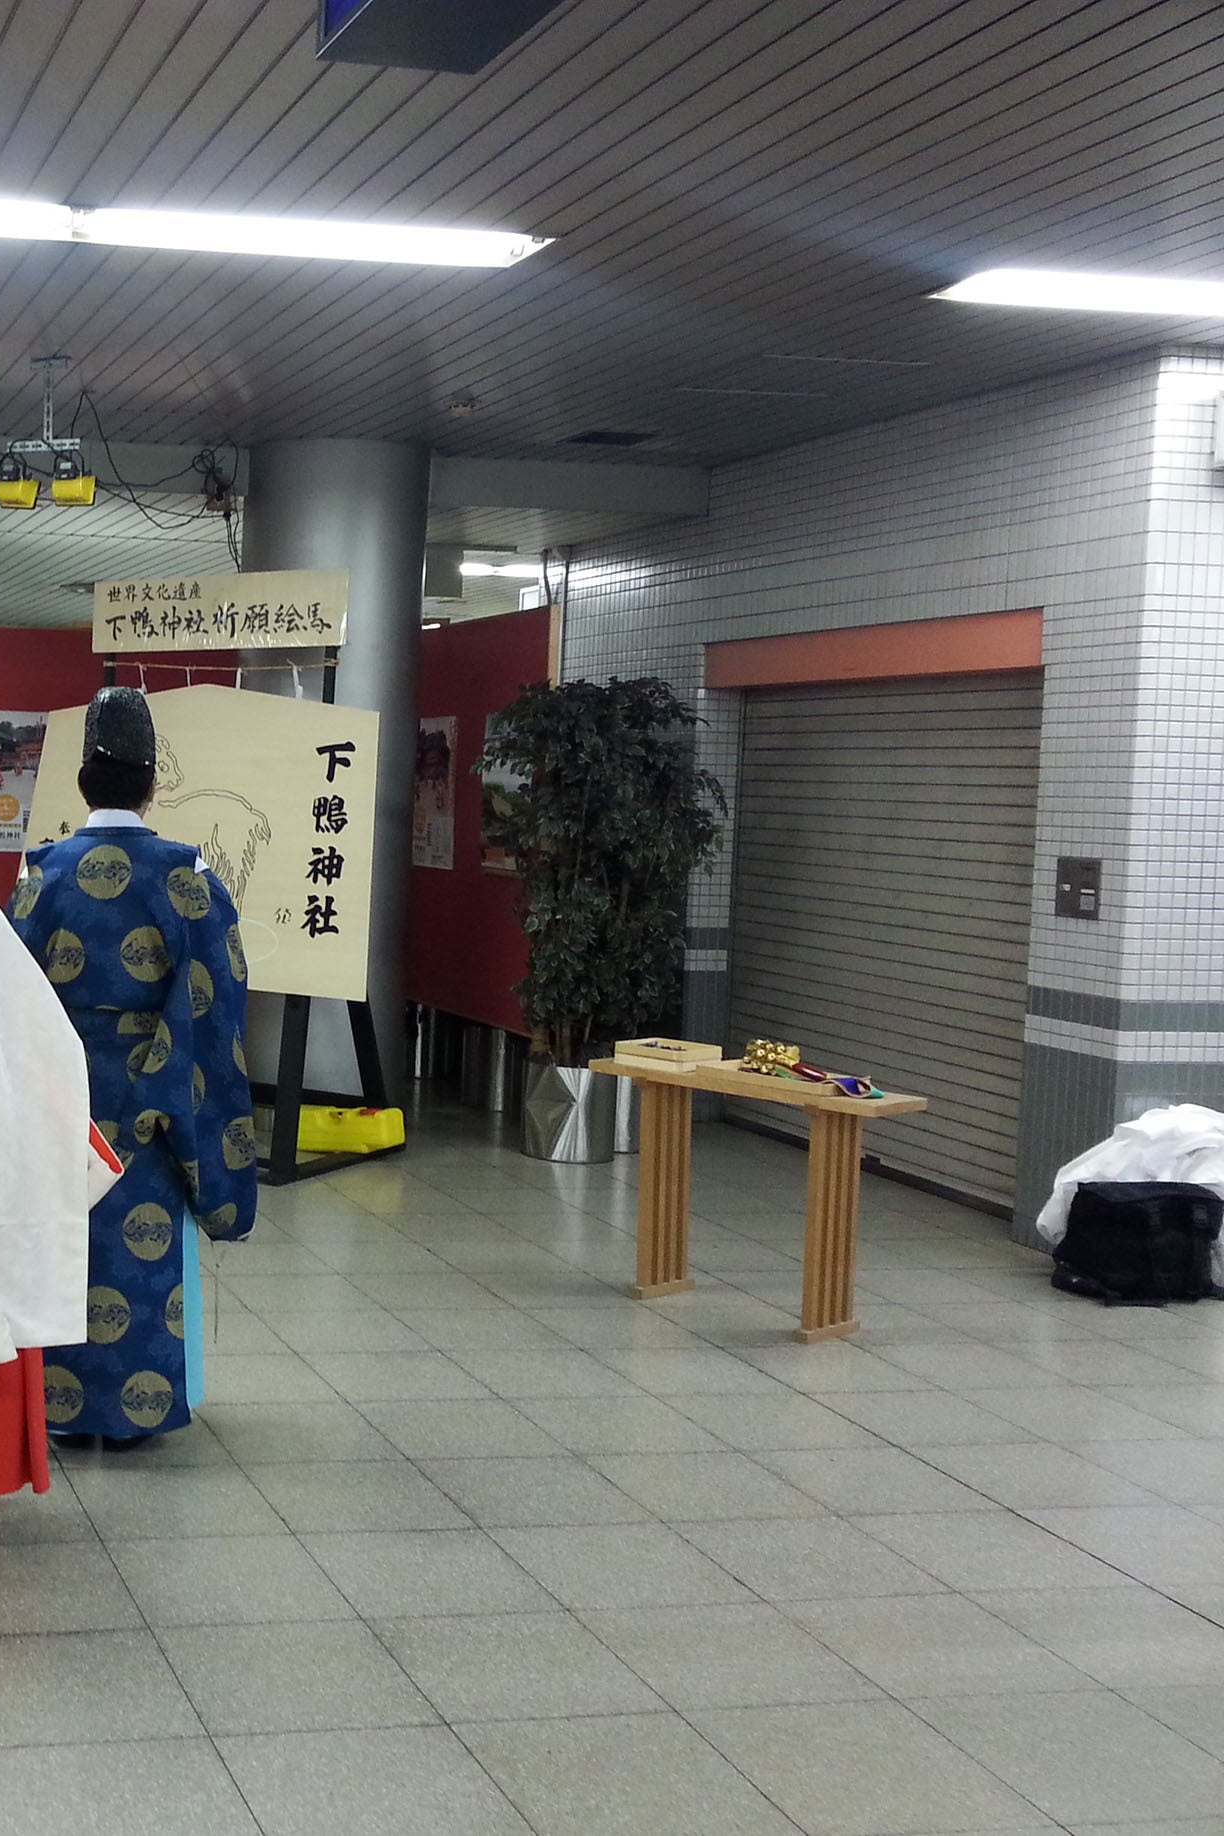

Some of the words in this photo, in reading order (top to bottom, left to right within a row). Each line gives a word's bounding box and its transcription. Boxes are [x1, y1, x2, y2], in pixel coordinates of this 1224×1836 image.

[107, 582, 202, 603] 世界文化遺産
[105, 602, 332, 641] 下鴨神社祈願絵馬
[301, 741, 356, 938] 下鴨神社
